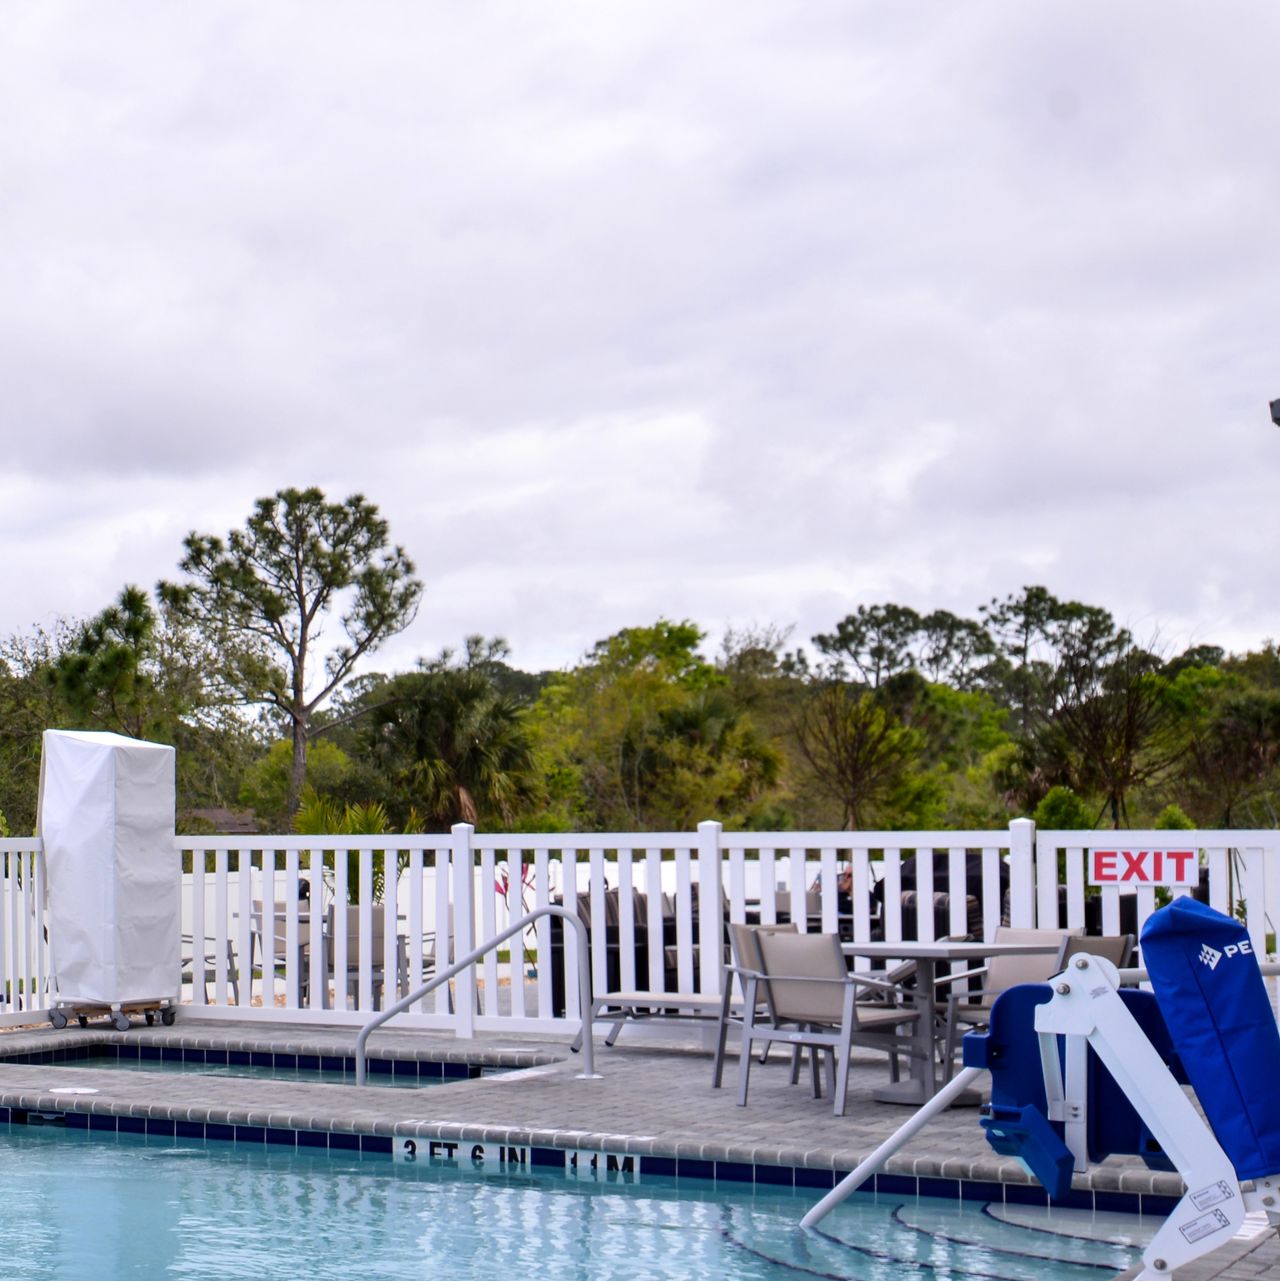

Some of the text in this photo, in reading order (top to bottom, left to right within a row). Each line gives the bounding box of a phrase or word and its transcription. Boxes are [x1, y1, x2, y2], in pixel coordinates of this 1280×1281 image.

[1094, 851, 1194, 882] EXIT
[429, 1141, 458, 1158] FT
[499, 1146, 526, 1164] IN
[606, 1154, 634, 1172] M
